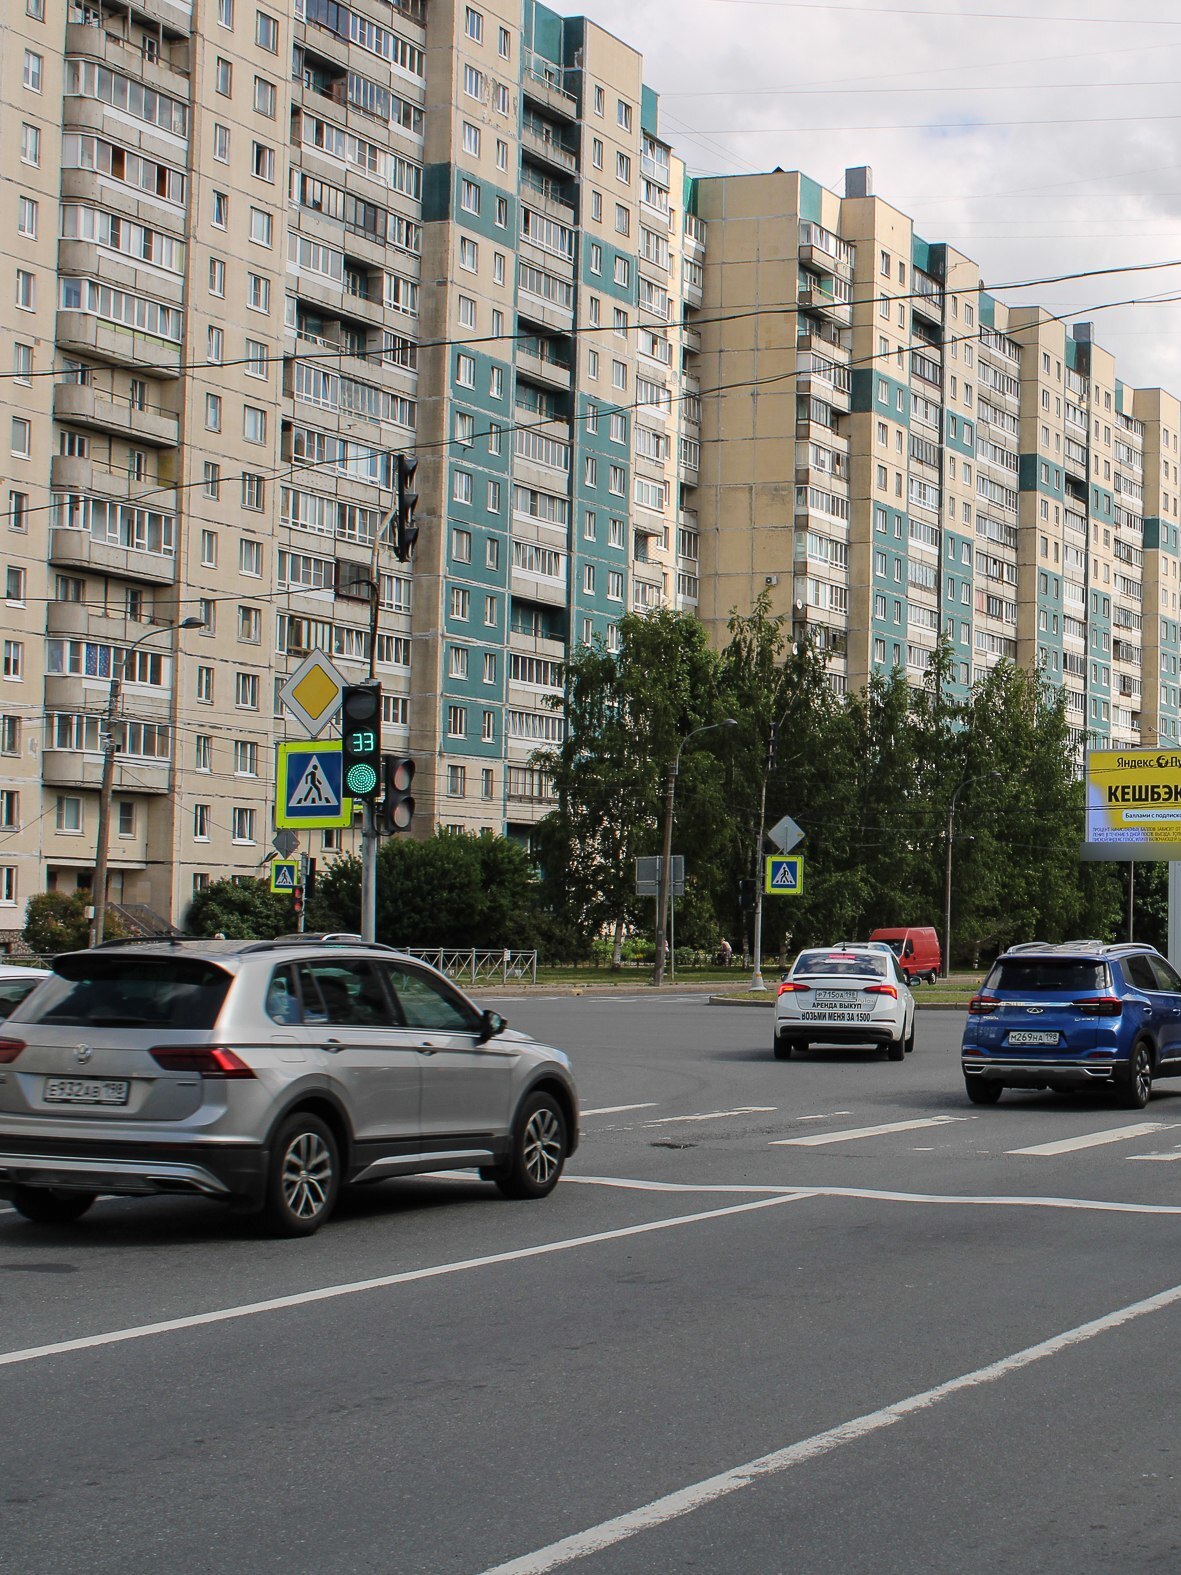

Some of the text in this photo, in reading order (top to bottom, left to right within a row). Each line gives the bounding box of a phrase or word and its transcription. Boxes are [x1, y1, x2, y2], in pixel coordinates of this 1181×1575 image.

[352, 732, 374, 752] 33
[1116, 757, 1154, 769] Яндекс
[811, 1002, 838, 1010] АРЕНДА
[827, 1012, 846, 1022] МЕНЯ
[846, 1013, 855, 1022] ЗА
[856, 1013, 871, 1022] 1500
